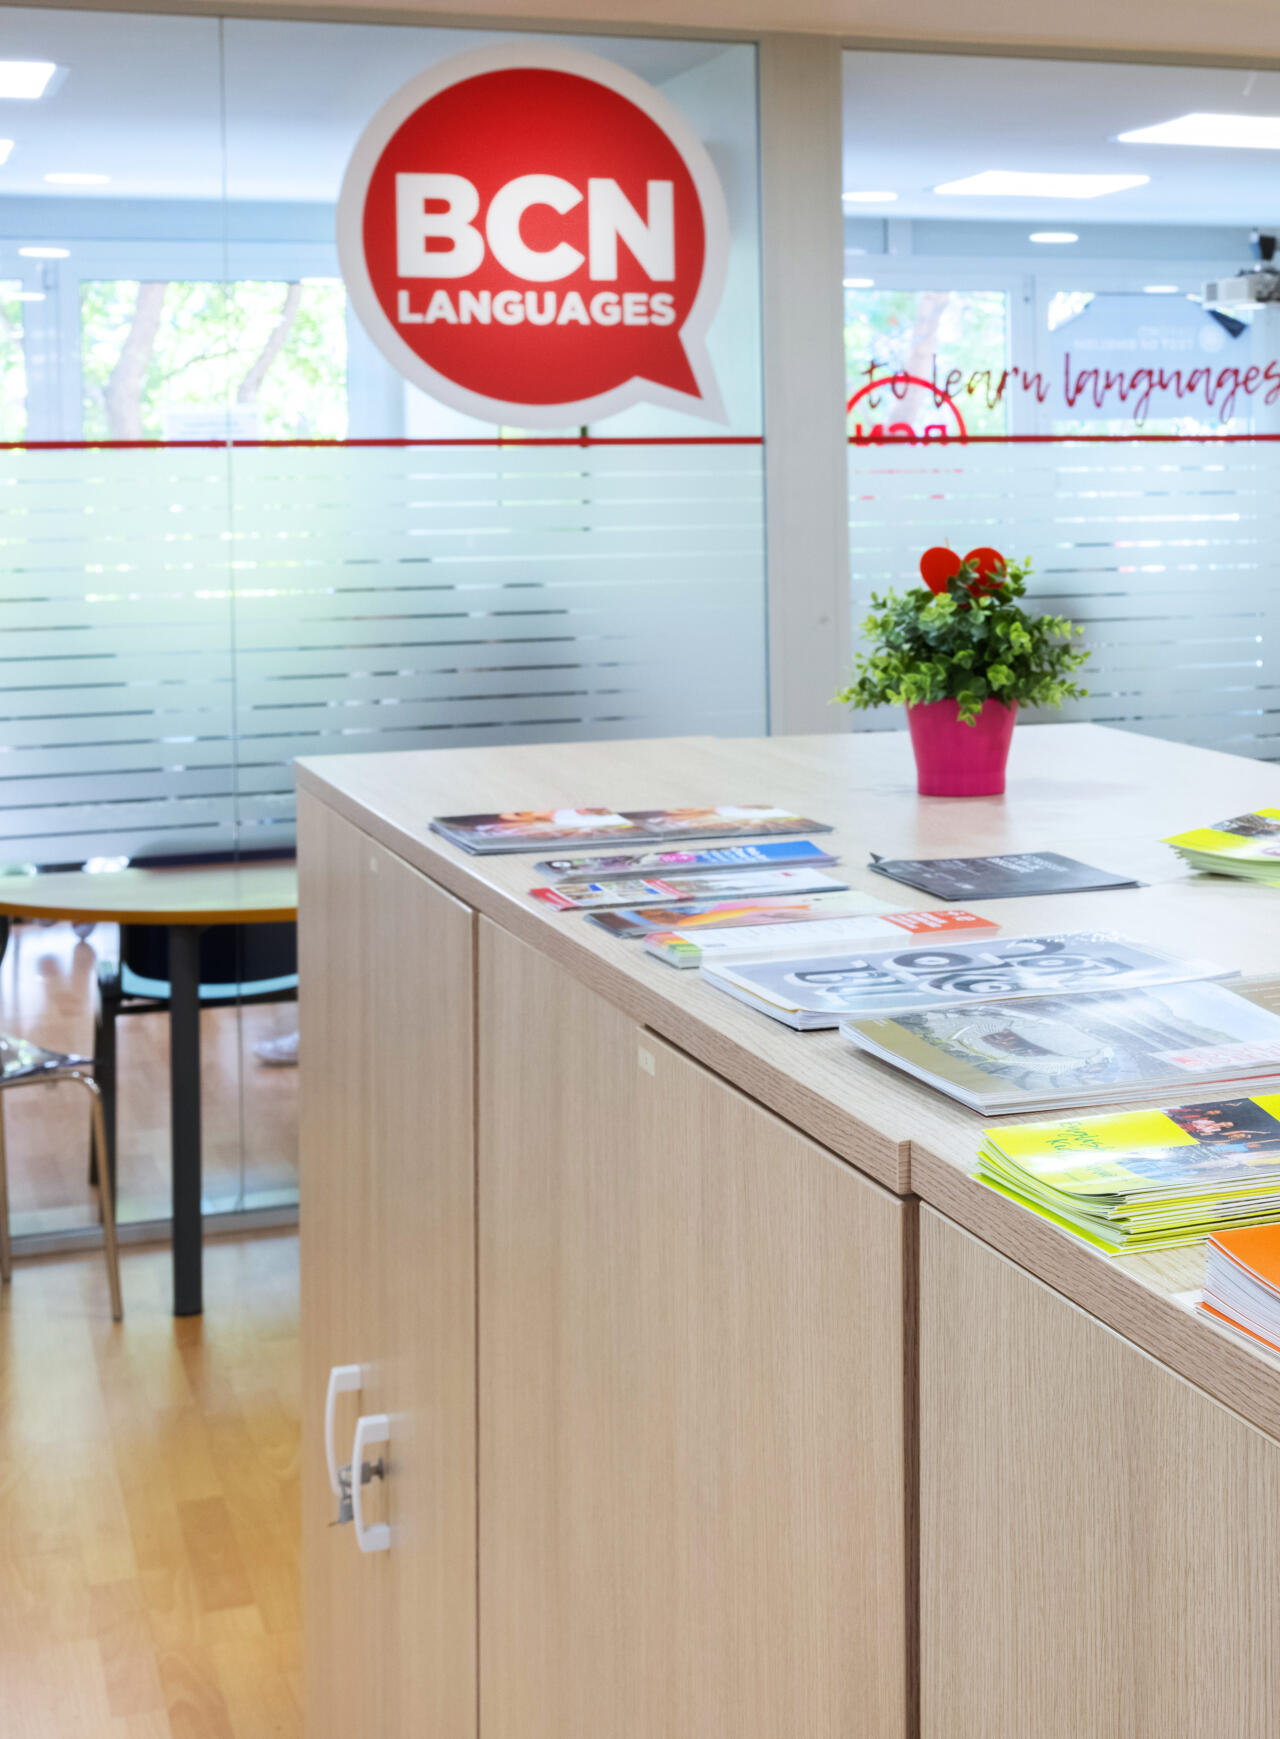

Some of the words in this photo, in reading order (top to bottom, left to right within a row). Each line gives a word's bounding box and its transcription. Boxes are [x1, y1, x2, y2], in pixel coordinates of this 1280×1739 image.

[395, 172, 677, 283] BCN
[397, 290, 677, 327] LANGUAGES
[861, 359, 909, 409] to
[932, 353, 1051, 409] learn
